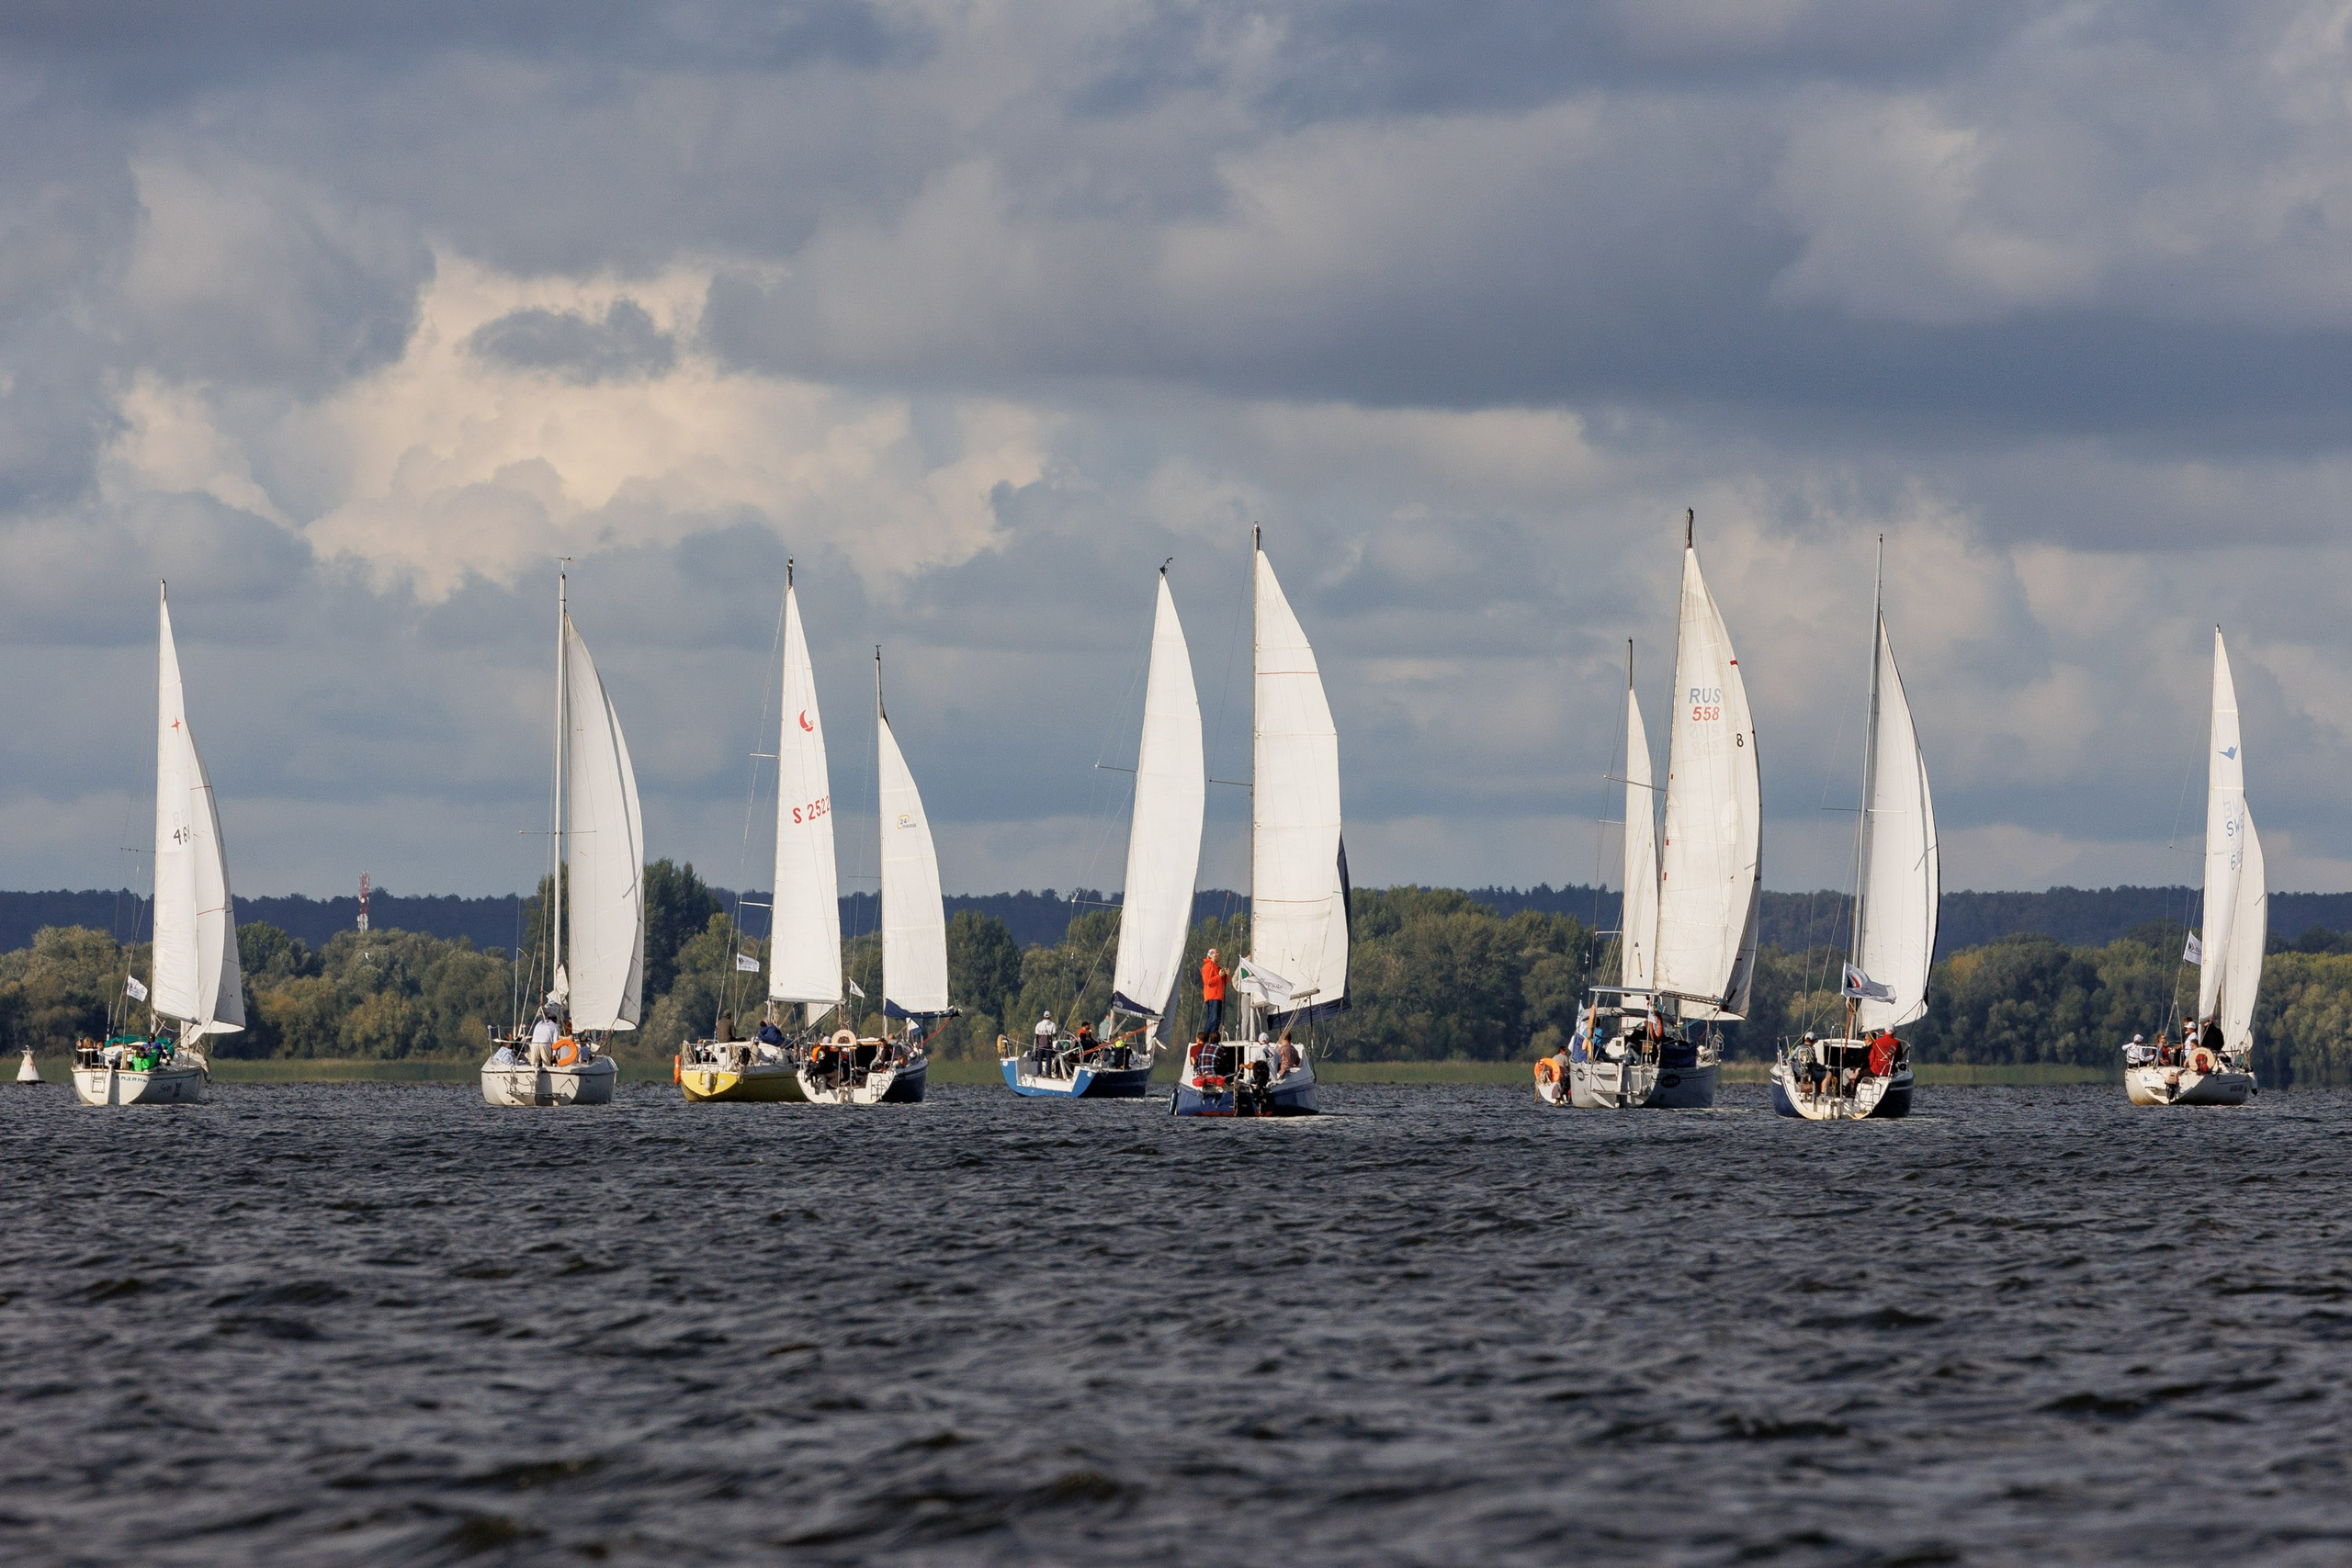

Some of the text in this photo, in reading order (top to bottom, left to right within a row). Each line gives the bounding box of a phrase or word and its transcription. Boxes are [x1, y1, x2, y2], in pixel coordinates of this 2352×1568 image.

[1689, 688, 1721, 704] RUS
[1692, 706, 1720, 721] 558
[1736, 733, 1744, 748] 8
[793, 795, 831, 824] S 2522
